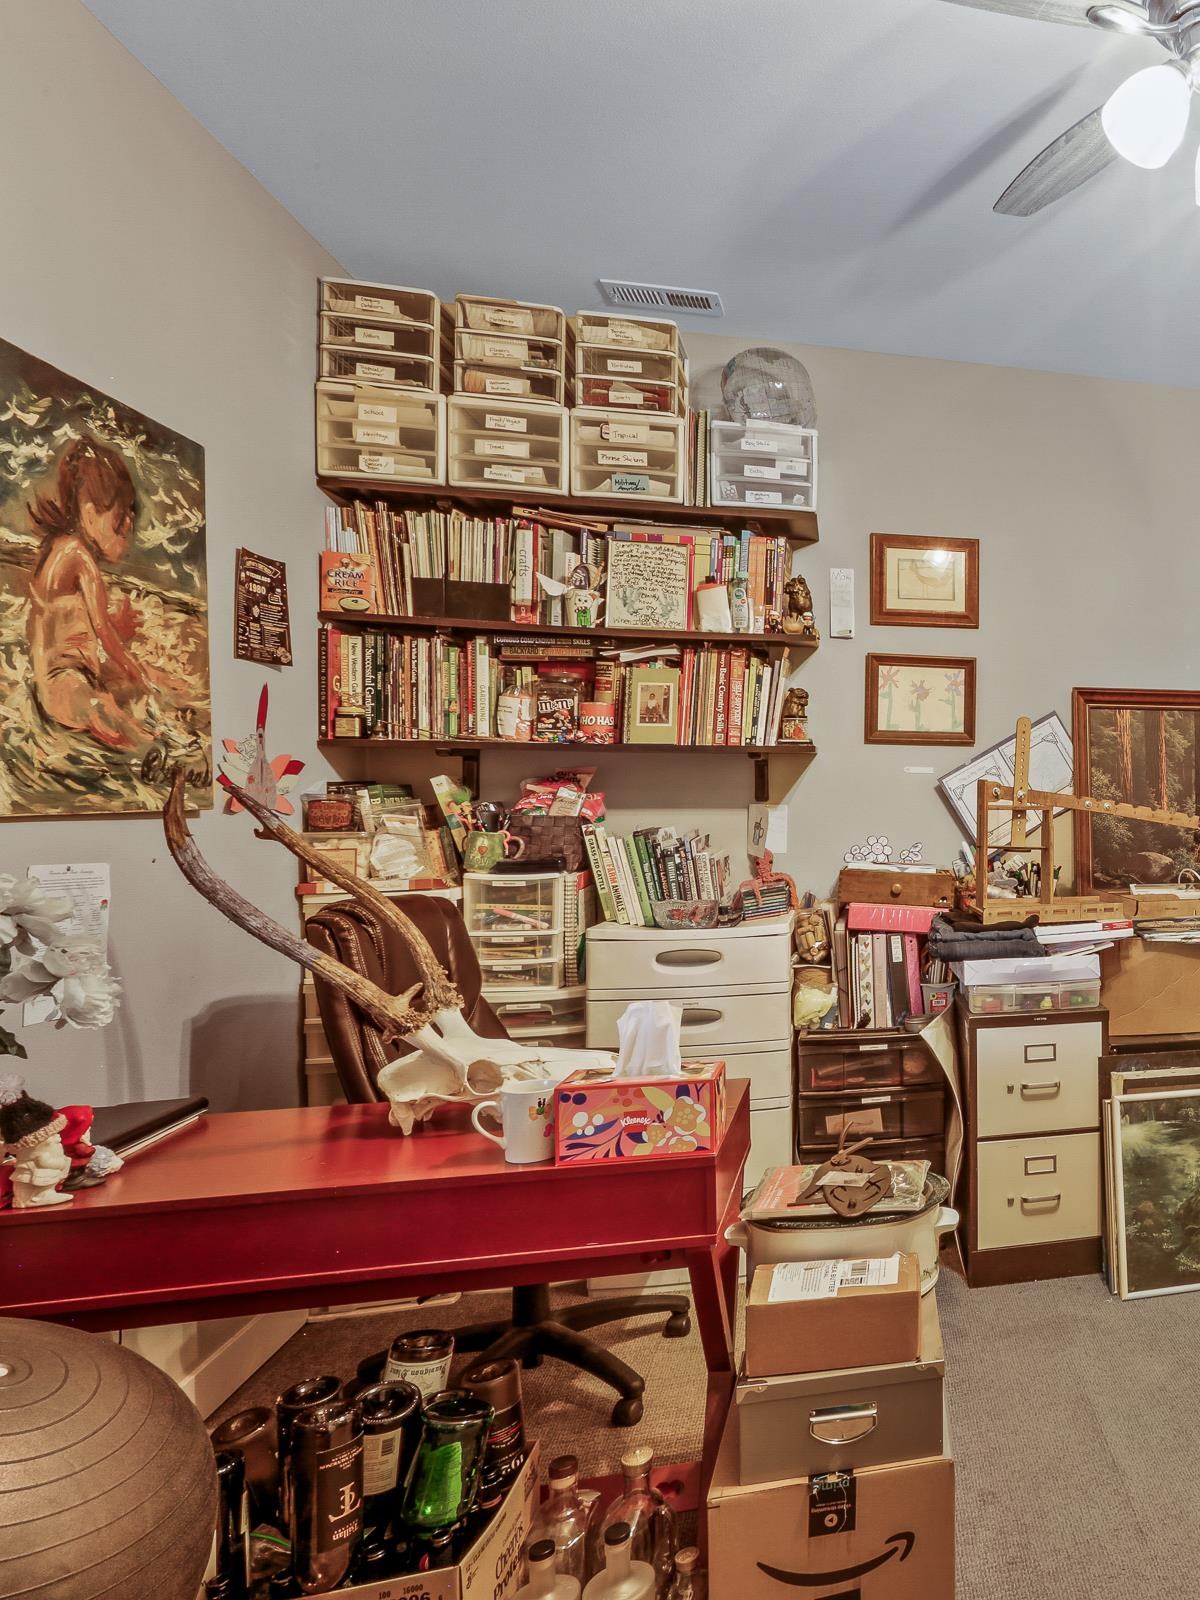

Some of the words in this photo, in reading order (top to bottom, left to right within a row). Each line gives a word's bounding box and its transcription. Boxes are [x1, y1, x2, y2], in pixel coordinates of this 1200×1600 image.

[327, 569, 365, 580] CREAM
[518, 549, 531, 577] crafts
[334, 579, 358, 588] RICE
[365, 648, 375, 686] Successful
[718, 667, 727, 686] Basic
[479, 685, 487, 722] GARDENING
[715, 685, 727, 713] Country
[715, 712, 725, 732] Skills
[588, 838, 601, 870] GRASS-FED
[595, 869, 606, 891] CATTLE
[606, 863, 615, 885] FARM
[611, 883, 625, 913] ANIMALS
[620, 1116, 651, 1128] Kleenex
[813, 1479, 850, 1492] prim
